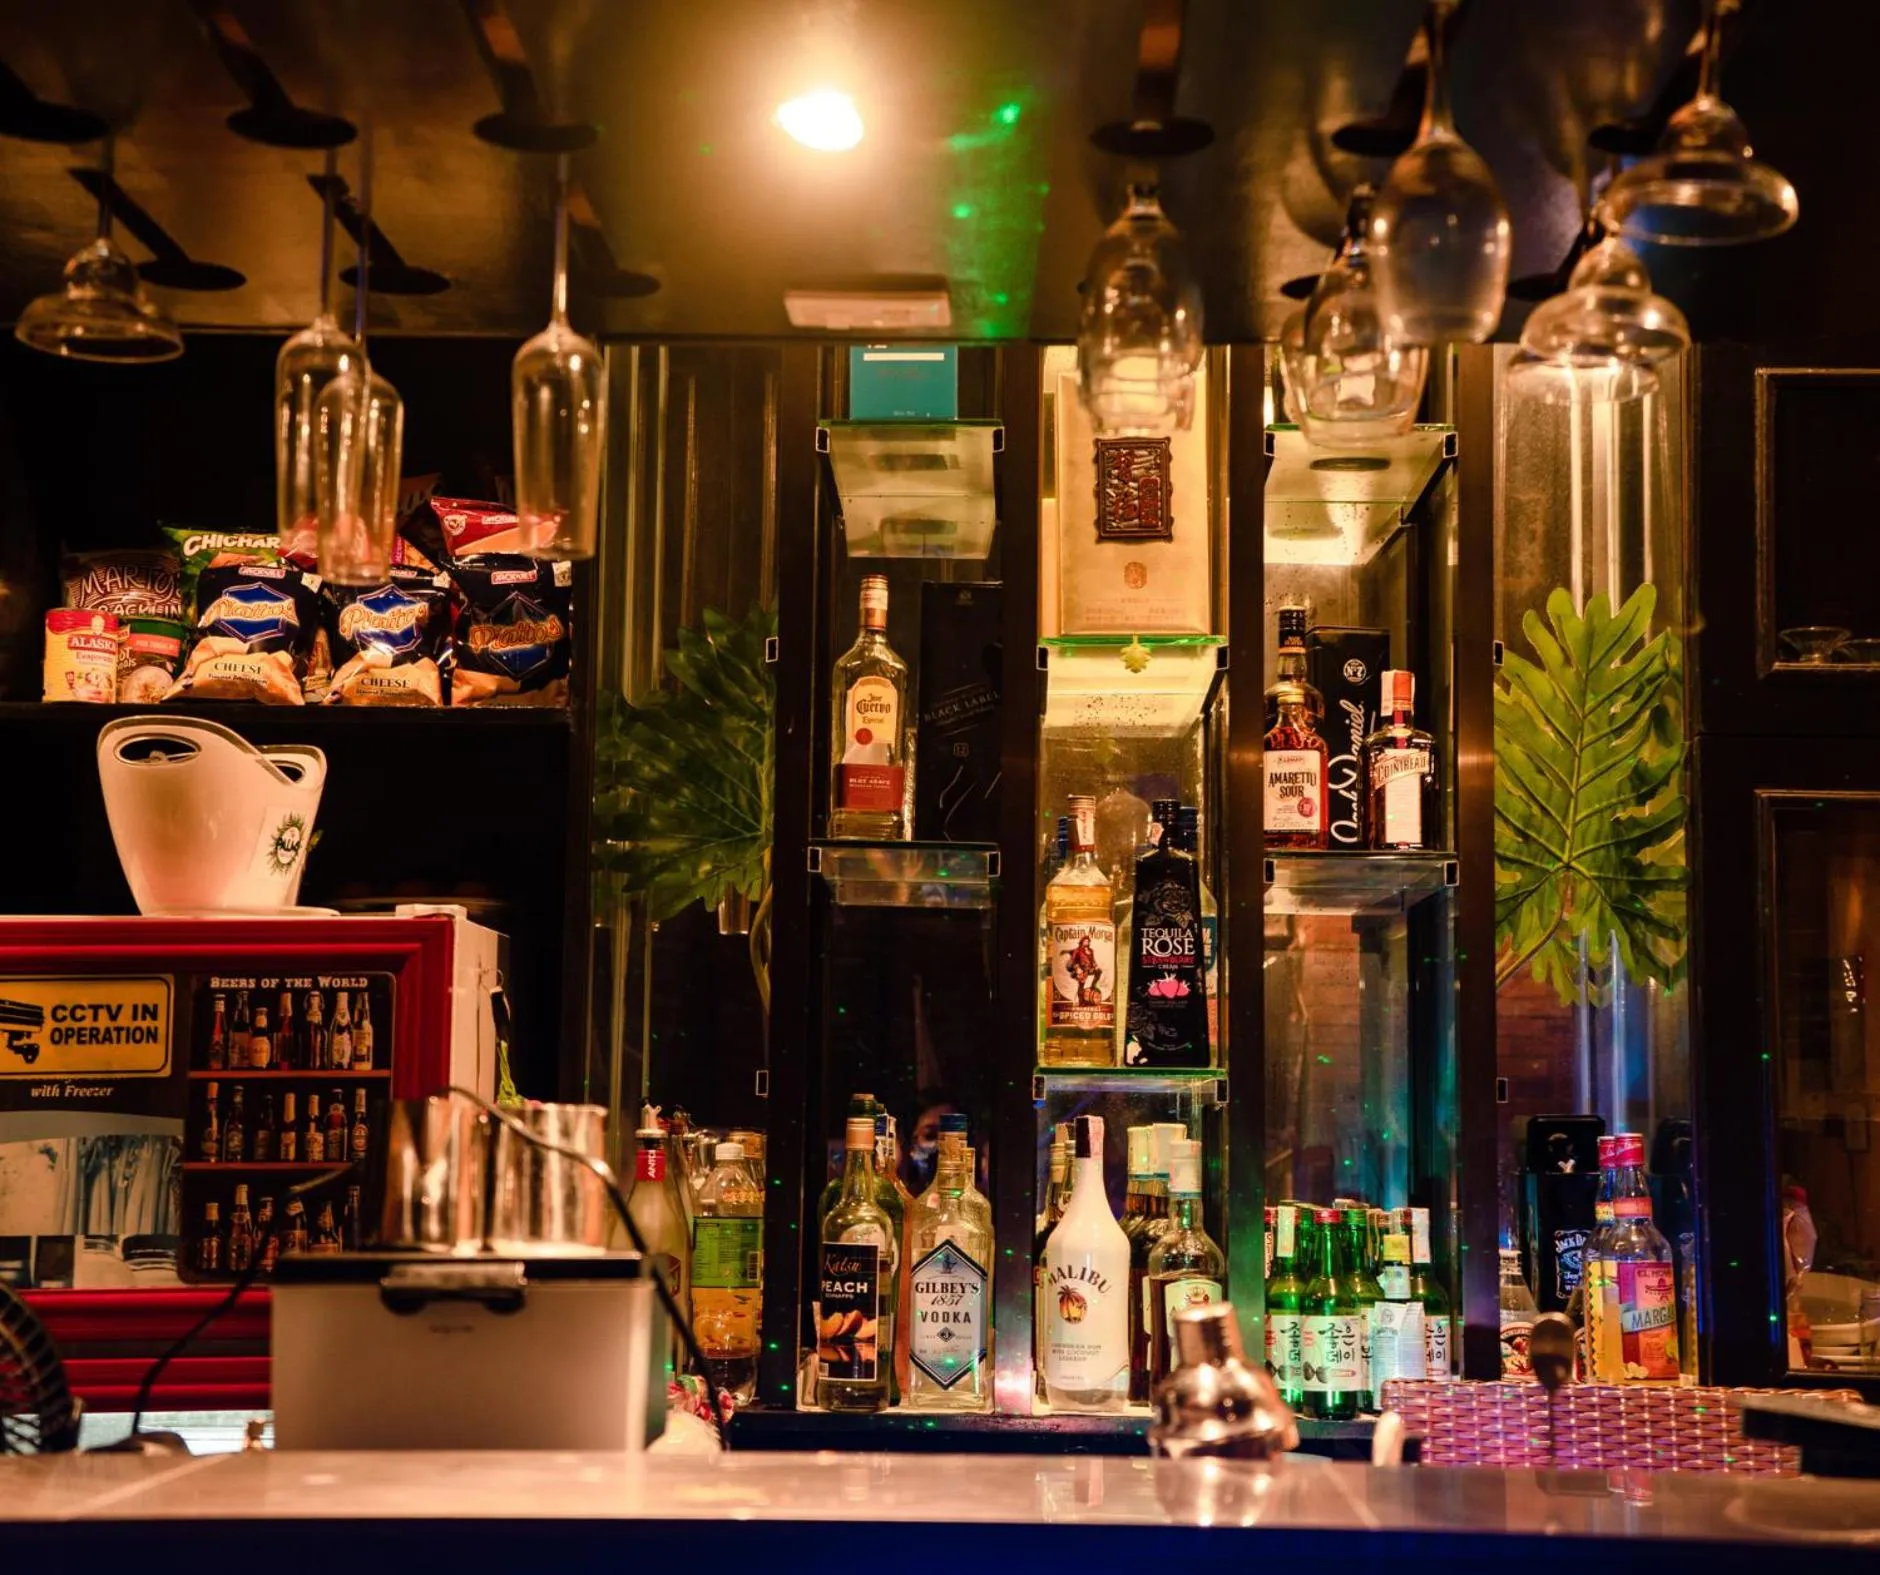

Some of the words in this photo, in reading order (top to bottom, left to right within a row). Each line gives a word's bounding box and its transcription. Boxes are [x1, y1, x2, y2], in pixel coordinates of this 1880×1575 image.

[213, 662, 263, 675] CHEESE
[360, 677, 411, 689] CHEESE
[856, 699, 891, 714] Cuervo
[923, 703, 961, 723] BLACK
[964, 690, 999, 709] LABEL
[1378, 756, 1426, 783] COINTREAU
[1268, 771, 1317, 788] AMARETTO
[1279, 785, 1305, 799] SOUR
[1055, 926, 1086, 942] Captain
[1140, 927, 1193, 939] TEQUILA
[1141, 937, 1196, 957] ROSE
[50, 1004, 124, 1023] CCTV
[131, 1003, 159, 1022] IN
[50, 1025, 159, 1045] OPERATION
[30, 1084, 61, 1098] with
[64, 1083, 114, 1098] Freezer
[821, 1280, 868, 1293] PEACH
[1048, 1264, 1113, 1295] MALIBU
[914, 1281, 980, 1295] GILBEY'S
[931, 1294, 965, 1307] 1857
[920, 1311, 972, 1324] VODKA
